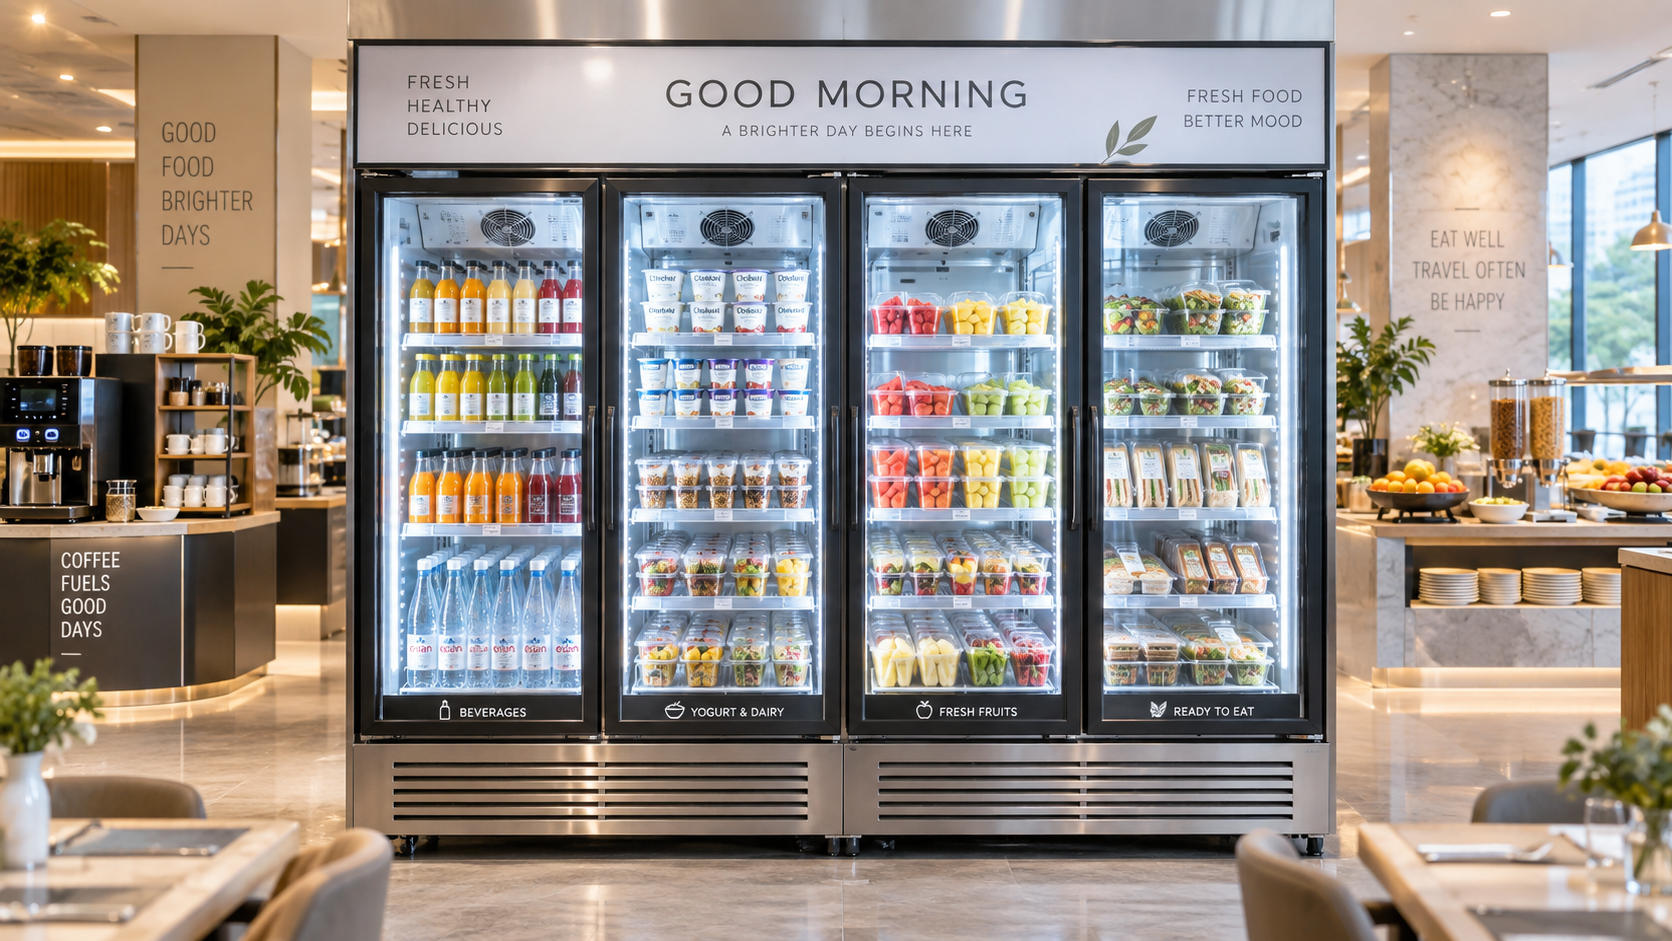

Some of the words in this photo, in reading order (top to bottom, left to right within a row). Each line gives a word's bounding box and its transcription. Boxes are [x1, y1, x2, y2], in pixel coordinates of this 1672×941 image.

[407, 74, 469, 90] FRESH
[665, 79, 795, 109] GOOD
[818, 79, 1027, 109] MORNING
[1187, 88, 1244, 104] FRESH
[1252, 89, 1303, 104] FOOD
[407, 98, 492, 113] HEALTHY
[407, 121, 503, 136] DELICIOUS
[1184, 114, 1244, 128] BETTER
[1251, 114, 1303, 128] MOOD
[161, 121, 217, 144] GOOD
[721, 124, 732, 137] A
[739, 124, 819, 137] BRIGHTER
[826, 124, 858, 137] DAY
[864, 124, 924, 138] BEGINS
[931, 124, 972, 138] HERE
[162, 155, 214, 178] FOOD
[162, 189, 253, 212] BRIGHTER
[161, 223, 211, 246] DAYS
[1430, 229, 1459, 249] EAT
[1463, 229, 1505, 249] WELL
[1412, 260, 1470, 280] TRAVEL
[1475, 260, 1526, 280] OFTEN
[1430, 292, 1449, 312] BE
[1454, 292, 1505, 311] HAPPY
[60, 551, 121, 569] COFFEE
[61, 574, 111, 592] FUELS
[60, 597, 107, 615] GOOD
[61, 620, 103, 639] DAYS
[459, 707, 527, 718] BEVERAGES
[690, 707, 737, 718] YOGURT
[739, 707, 748, 718] &
[750, 707, 785, 717] DAIRY
[939, 706, 975, 717] FRESH
[978, 706, 1018, 717] FRUITS
[1173, 706, 1212, 717] READY
[1213, 706, 1230, 717] TO
[1233, 706, 1255, 717] EAT
